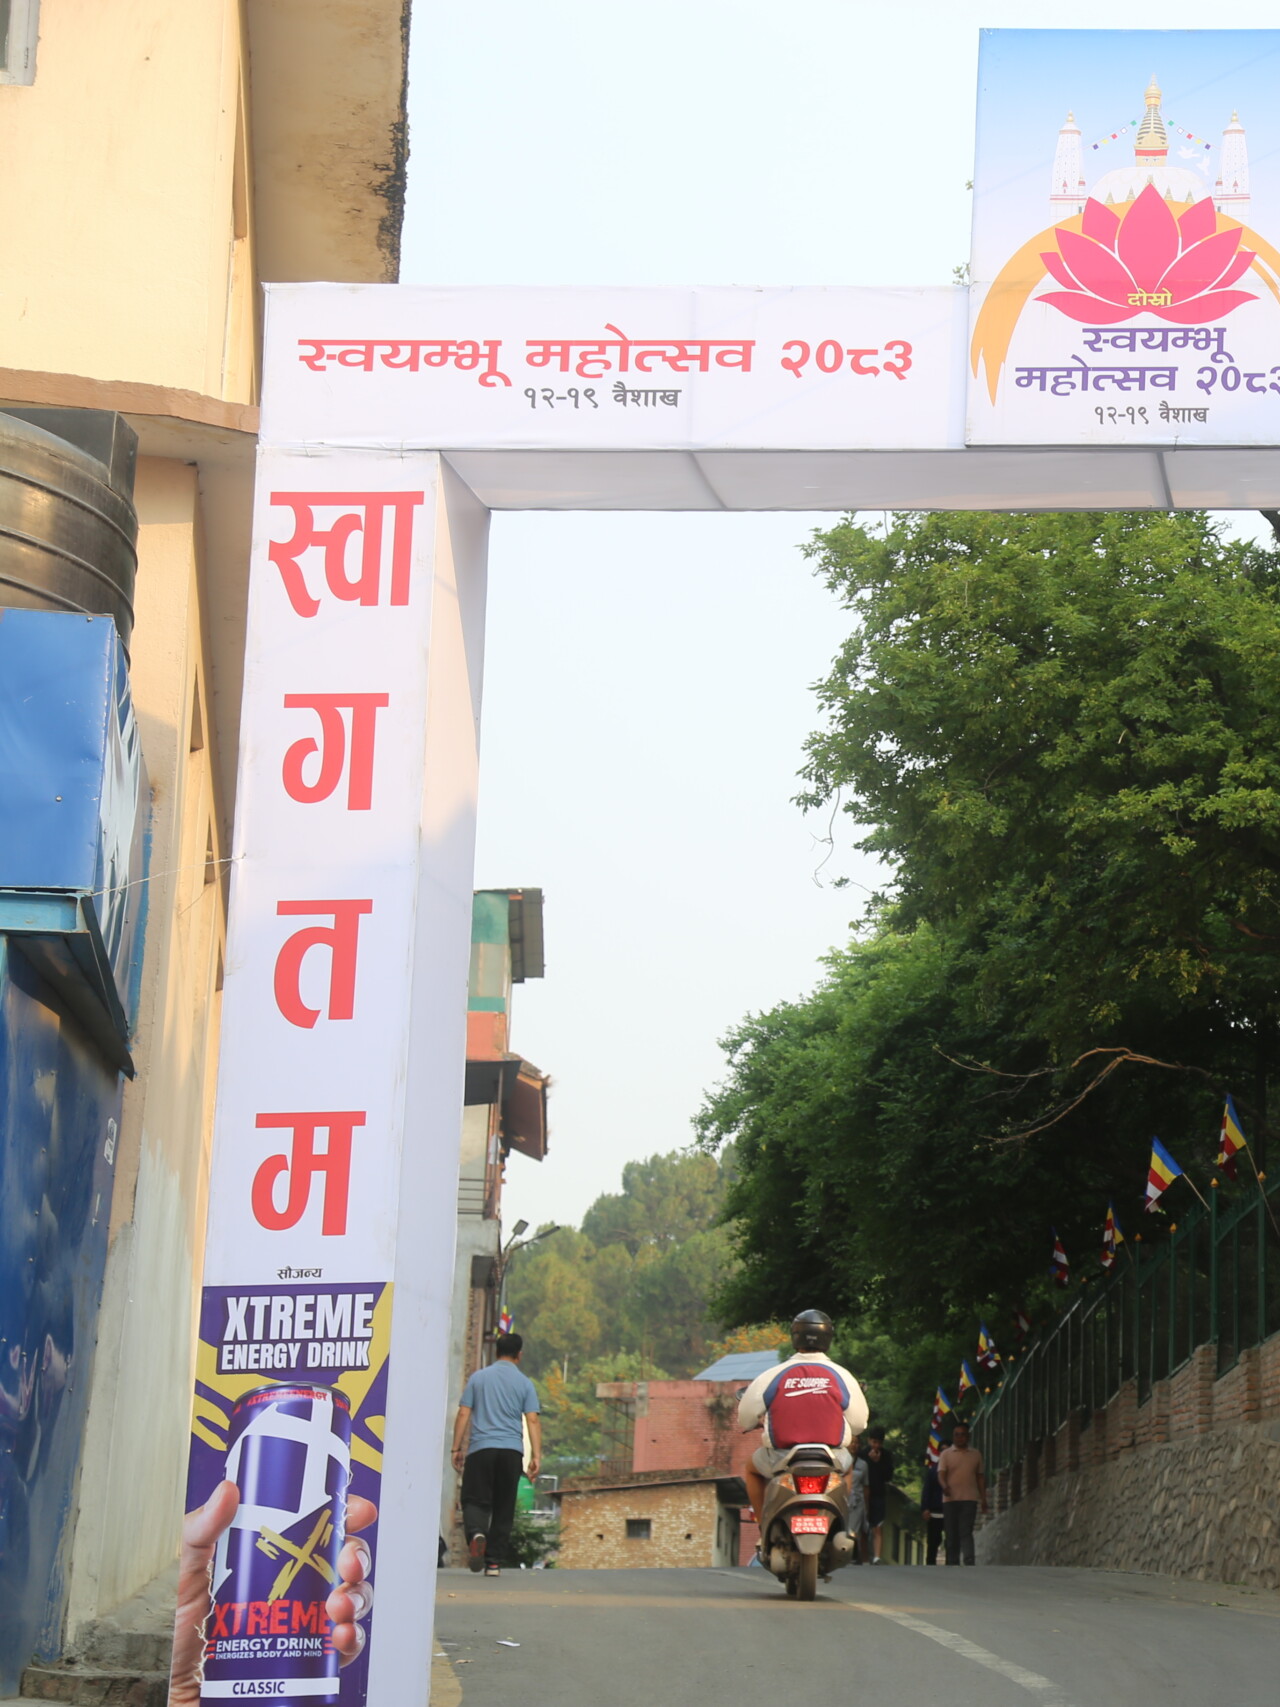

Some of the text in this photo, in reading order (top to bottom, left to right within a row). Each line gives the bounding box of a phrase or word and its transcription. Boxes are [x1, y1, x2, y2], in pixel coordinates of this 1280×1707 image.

[1127, 288, 1173, 306] दोस्रो
[298, 323, 912, 387] स्वयम्भू महोत्सव २०८३
[1082, 328, 1234, 364] स्वयम्भू
[1015, 354, 1178, 396] महोत्सव
[524, 380, 682, 409] १२-१९ वैशाख
[1094, 400, 1209, 424] १२-१९ वैशाख
[277, 1265, 323, 1280] सौजन्य
[223, 1293, 374, 1341] XTREME
[221, 1341, 370, 1370] ENERGY DRINK
[211, 1600, 331, 1637] XTREME
[215, 1651, 254, 1660] ENERGIZES
[256, 1650, 281, 1658] BODY
[216, 1637, 322, 1652] ENERGY DRINK
[232, 1681, 286, 1695] CLASSIC
